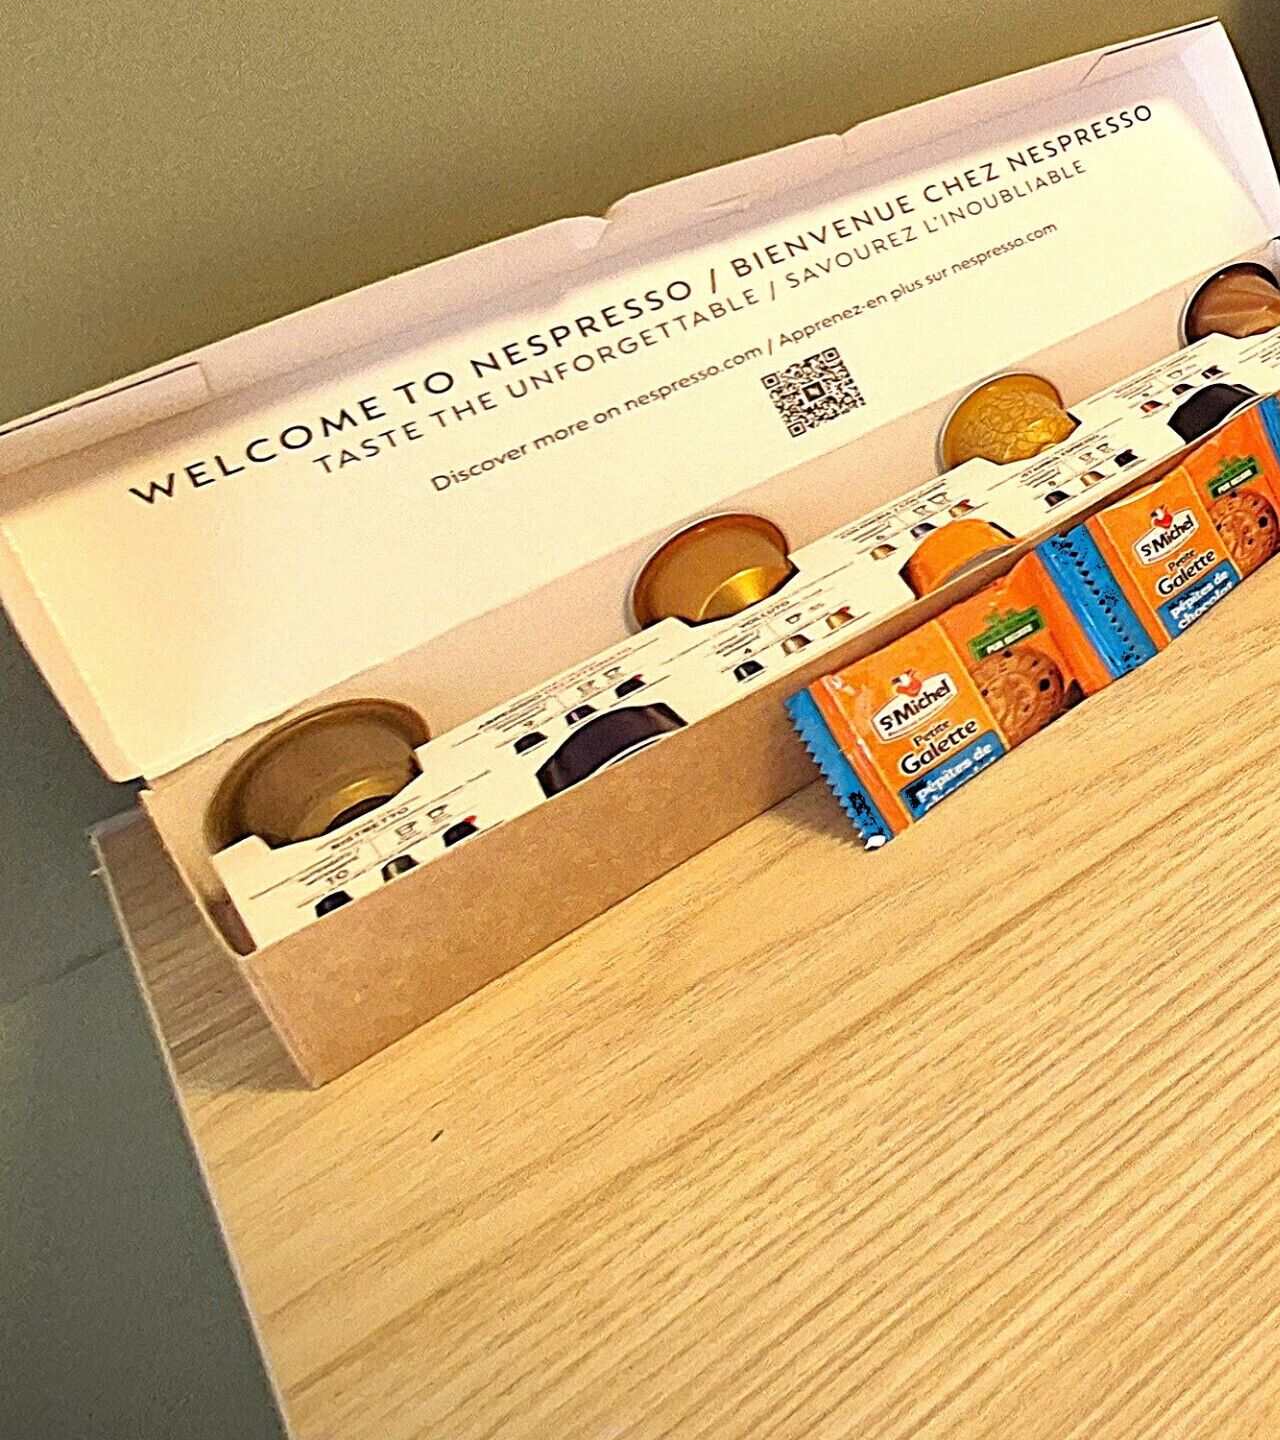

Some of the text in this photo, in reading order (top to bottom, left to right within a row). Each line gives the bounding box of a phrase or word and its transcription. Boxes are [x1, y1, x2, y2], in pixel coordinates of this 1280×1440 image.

[128, 104, 1153, 504] WELCOME TO NESPRESSO / BIENVENUE CHEZ NESPRESSO
[312, 421, 425, 474] TASTE
[428, 391, 498, 428] THE
[505, 288, 760, 399] UNFORGETTABLE
[769, 280, 776, 301] /
[785, 226, 918, 289] SAVOUREZ
[430, 223, 1058, 492] Discover more on nespresso.com / Apprenez-en plus sur nespresso.com
[1151, 514, 1195, 553] Michel
[1157, 550, 1216, 596] Galette
[893, 678, 951, 726] Michel
[900, 720, 978, 775] Galette
